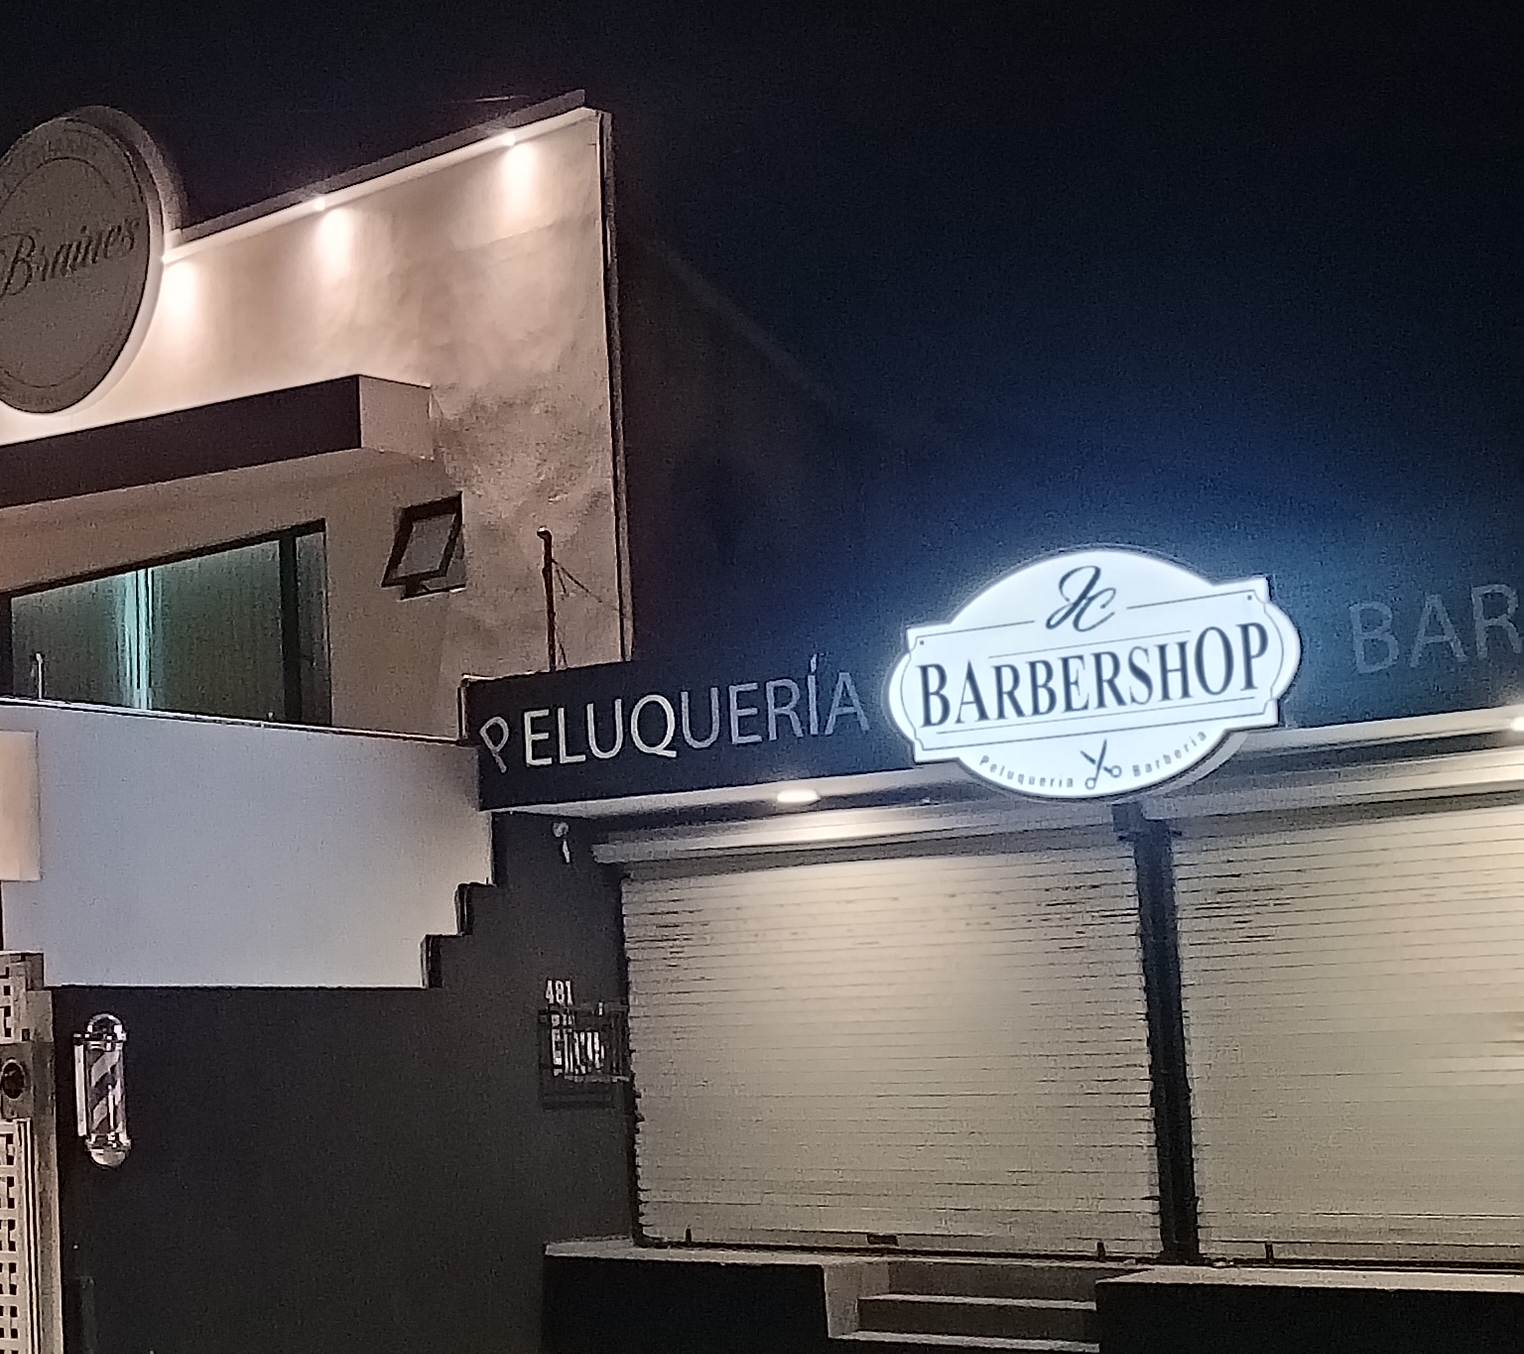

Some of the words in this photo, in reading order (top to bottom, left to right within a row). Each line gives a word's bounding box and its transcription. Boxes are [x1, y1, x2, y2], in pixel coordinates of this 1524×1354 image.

[917, 622, 1269, 728] BARBERSHOP
[1349, 583, 1523, 674] BAR
[479, 653, 871, 773] PELUQUERÍA
